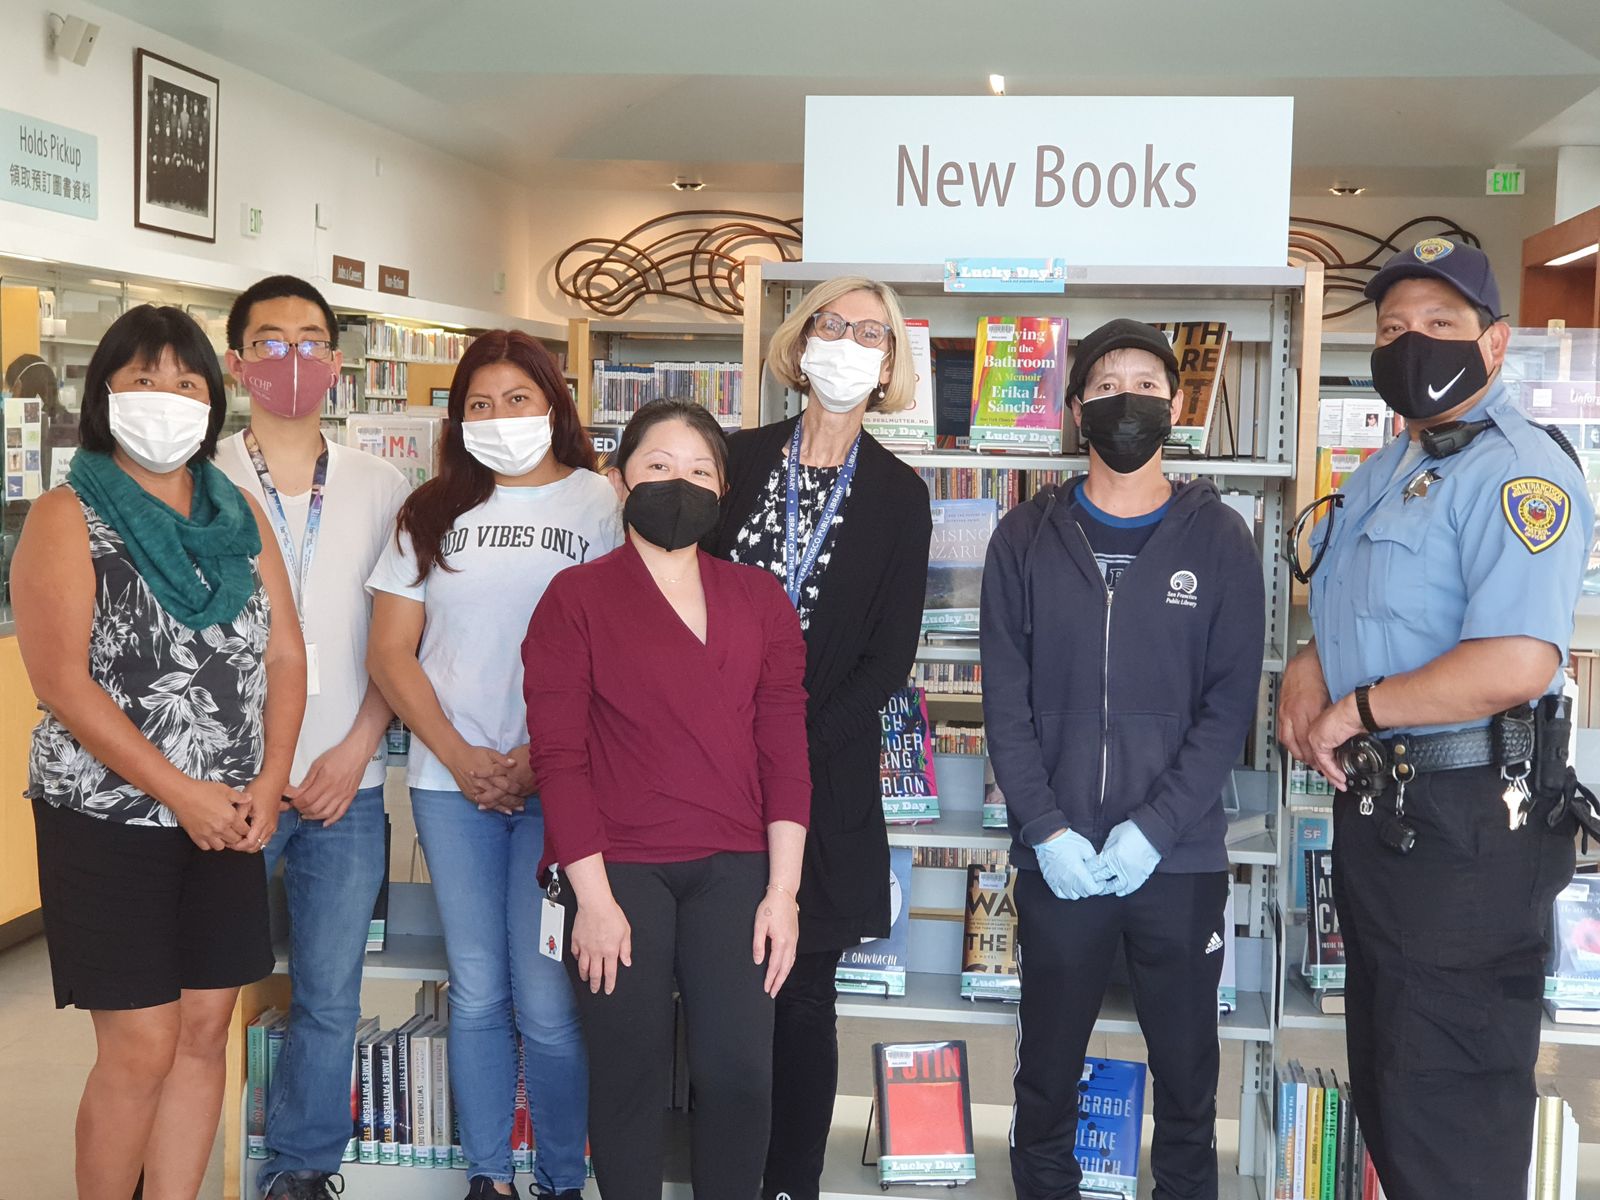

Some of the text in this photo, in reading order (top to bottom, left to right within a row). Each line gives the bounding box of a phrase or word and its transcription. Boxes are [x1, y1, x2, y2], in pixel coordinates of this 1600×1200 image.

[20, 125, 81, 173] Holds Pickup
[10, 163, 91, 203] 領取預訂圖書資料
[896, 143, 1198, 208] New Books
[1493, 171, 1520, 192] EXIT
[961, 266, 1048, 280] Lucky Day
[1014, 328, 1046, 343] ying
[1161, 322, 1226, 345] UTH
[1007, 345, 1034, 353] in the
[983, 355, 1056, 369] Bathroom
[1180, 348, 1219, 372] RE
[248, 376, 272, 391] CCHP
[1006, 373, 1041, 382] Memoir
[991, 385, 1046, 399] Erika L.
[987, 399, 1046, 414] Sánchez
[867, 427, 925, 438] cky Day
[985, 431, 1056, 444] Lucky Day
[592, 437, 617, 453] ED
[790, 440, 799, 463] PUBLIC
[789, 463, 797, 491] LIBRARY
[800, 537, 821, 577] FRANCISCO
[817, 512, 833, 537] PUBLIC
[828, 485, 844, 513] LIBRARY
[847, 443, 860, 468] LIBRARY
[931, 529, 991, 542] AISING
[441, 525, 590, 564] OOD VIBES ONLY
[788, 544, 795, 556] OF
[930, 545, 981, 559] ZARU
[1177, 592, 1197, 600] Francisco
[1180, 599, 1197, 608] Library
[922, 612, 980, 625] Lucky Da
[879, 697, 909, 714] ON
[881, 734, 923, 751] IDER
[880, 752, 912, 769] ING
[881, 776, 925, 794] RLON
[901, 801, 927, 813] Day
[1303, 829, 1321, 839] SF
[967, 892, 1017, 917] WA
[965, 933, 1007, 952] THE
[852, 952, 897, 966] ONWUACHI
[398, 1035, 406, 1071] DANIELLE
[361, 1059, 371, 1082] JAMES
[382, 1059, 391, 1083] JAMES
[362, 1083, 372, 1124] PATTERSON
[383, 1084, 392, 1125] PATTERSON
[515, 1082, 527, 1110] COOK
[417, 1085, 425, 1125] SWITCHBOARD
[1078, 1094, 1132, 1117] GRADE
[891, 1160, 960, 1172] Lucky Day
[1081, 1156, 1122, 1175] OUCH
[1098, 1178, 1124, 1191] Day
